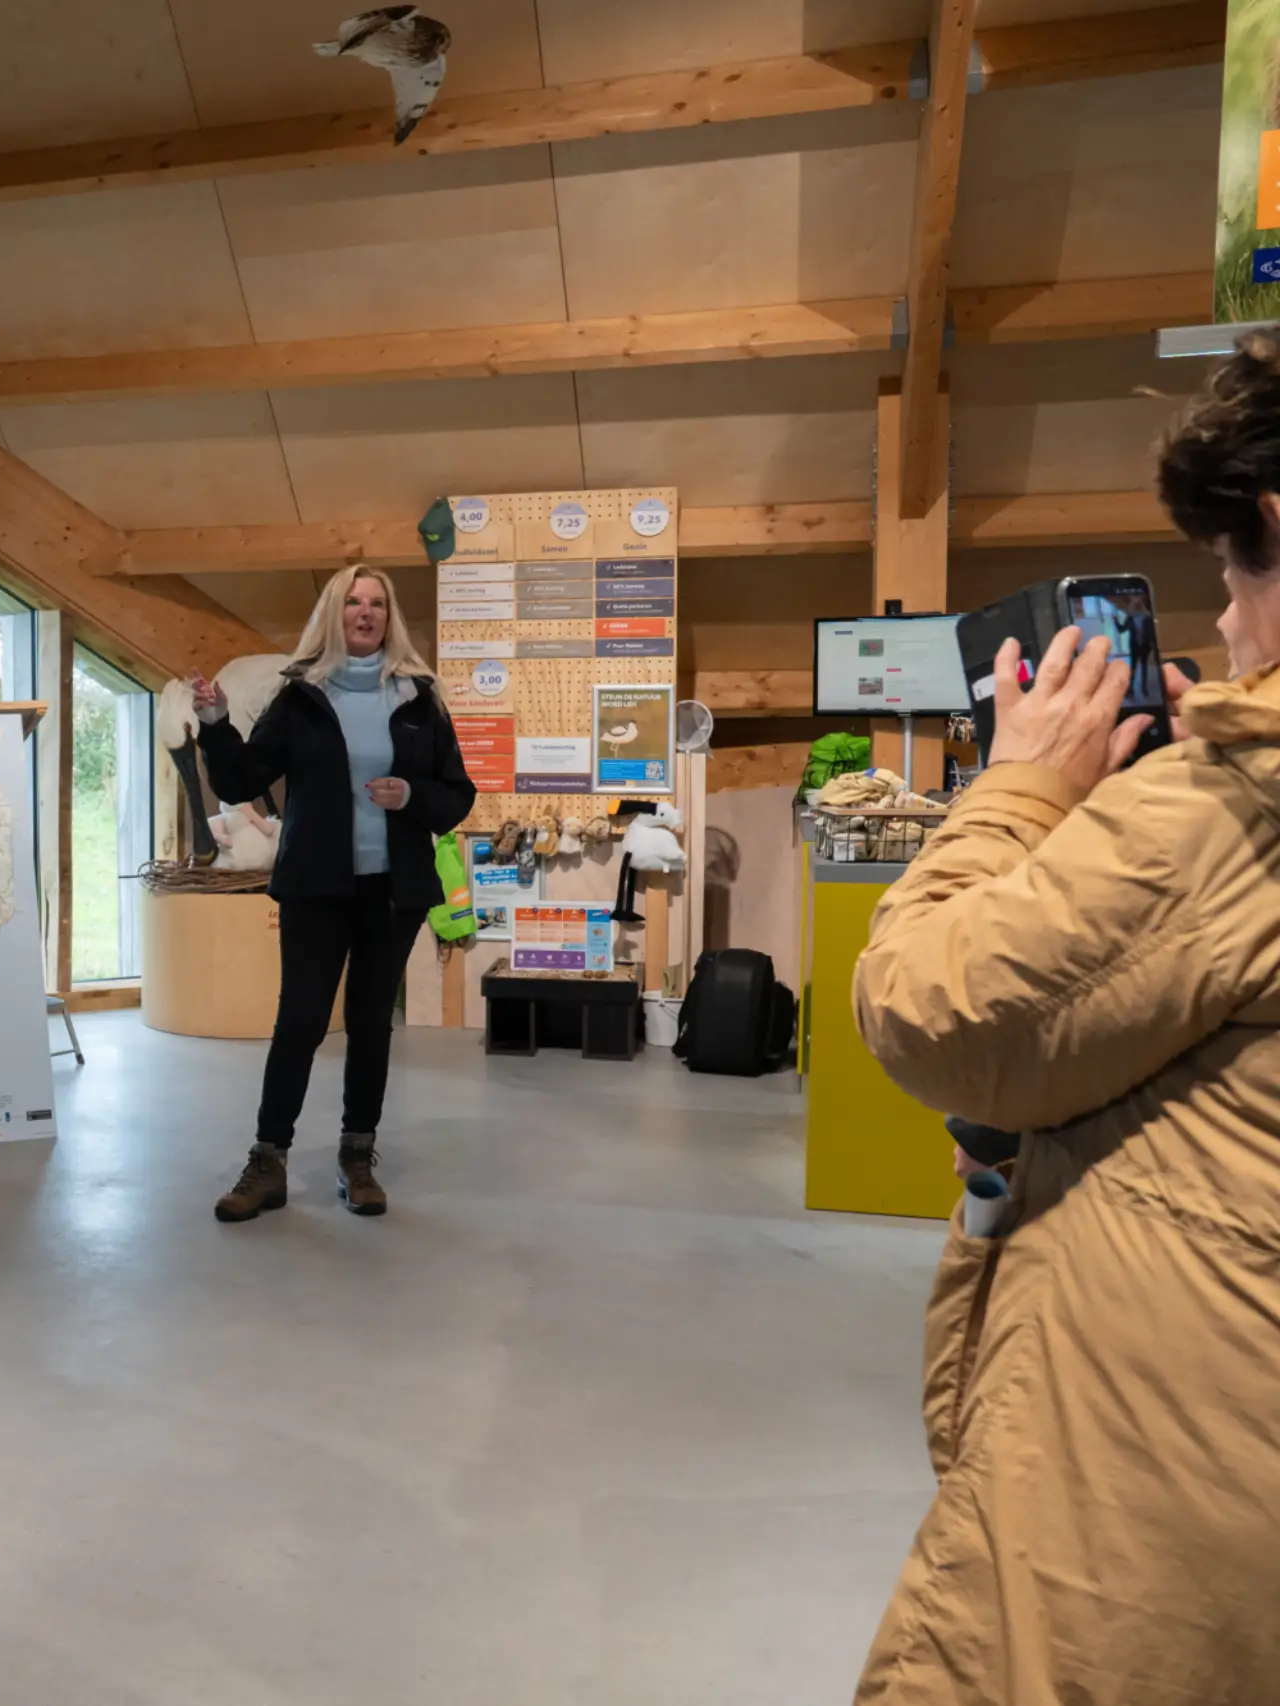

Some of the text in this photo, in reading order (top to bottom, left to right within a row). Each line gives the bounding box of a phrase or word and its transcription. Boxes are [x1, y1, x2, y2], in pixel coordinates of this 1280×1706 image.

[460, 511, 483, 523] 4,00
[637, 514, 661, 525] 9,25
[557, 517, 581, 529] 7,25
[622, 542, 648, 551] Gezin
[479, 675, 502, 686] 3,00
[633, 693, 662, 701] NATUUR
